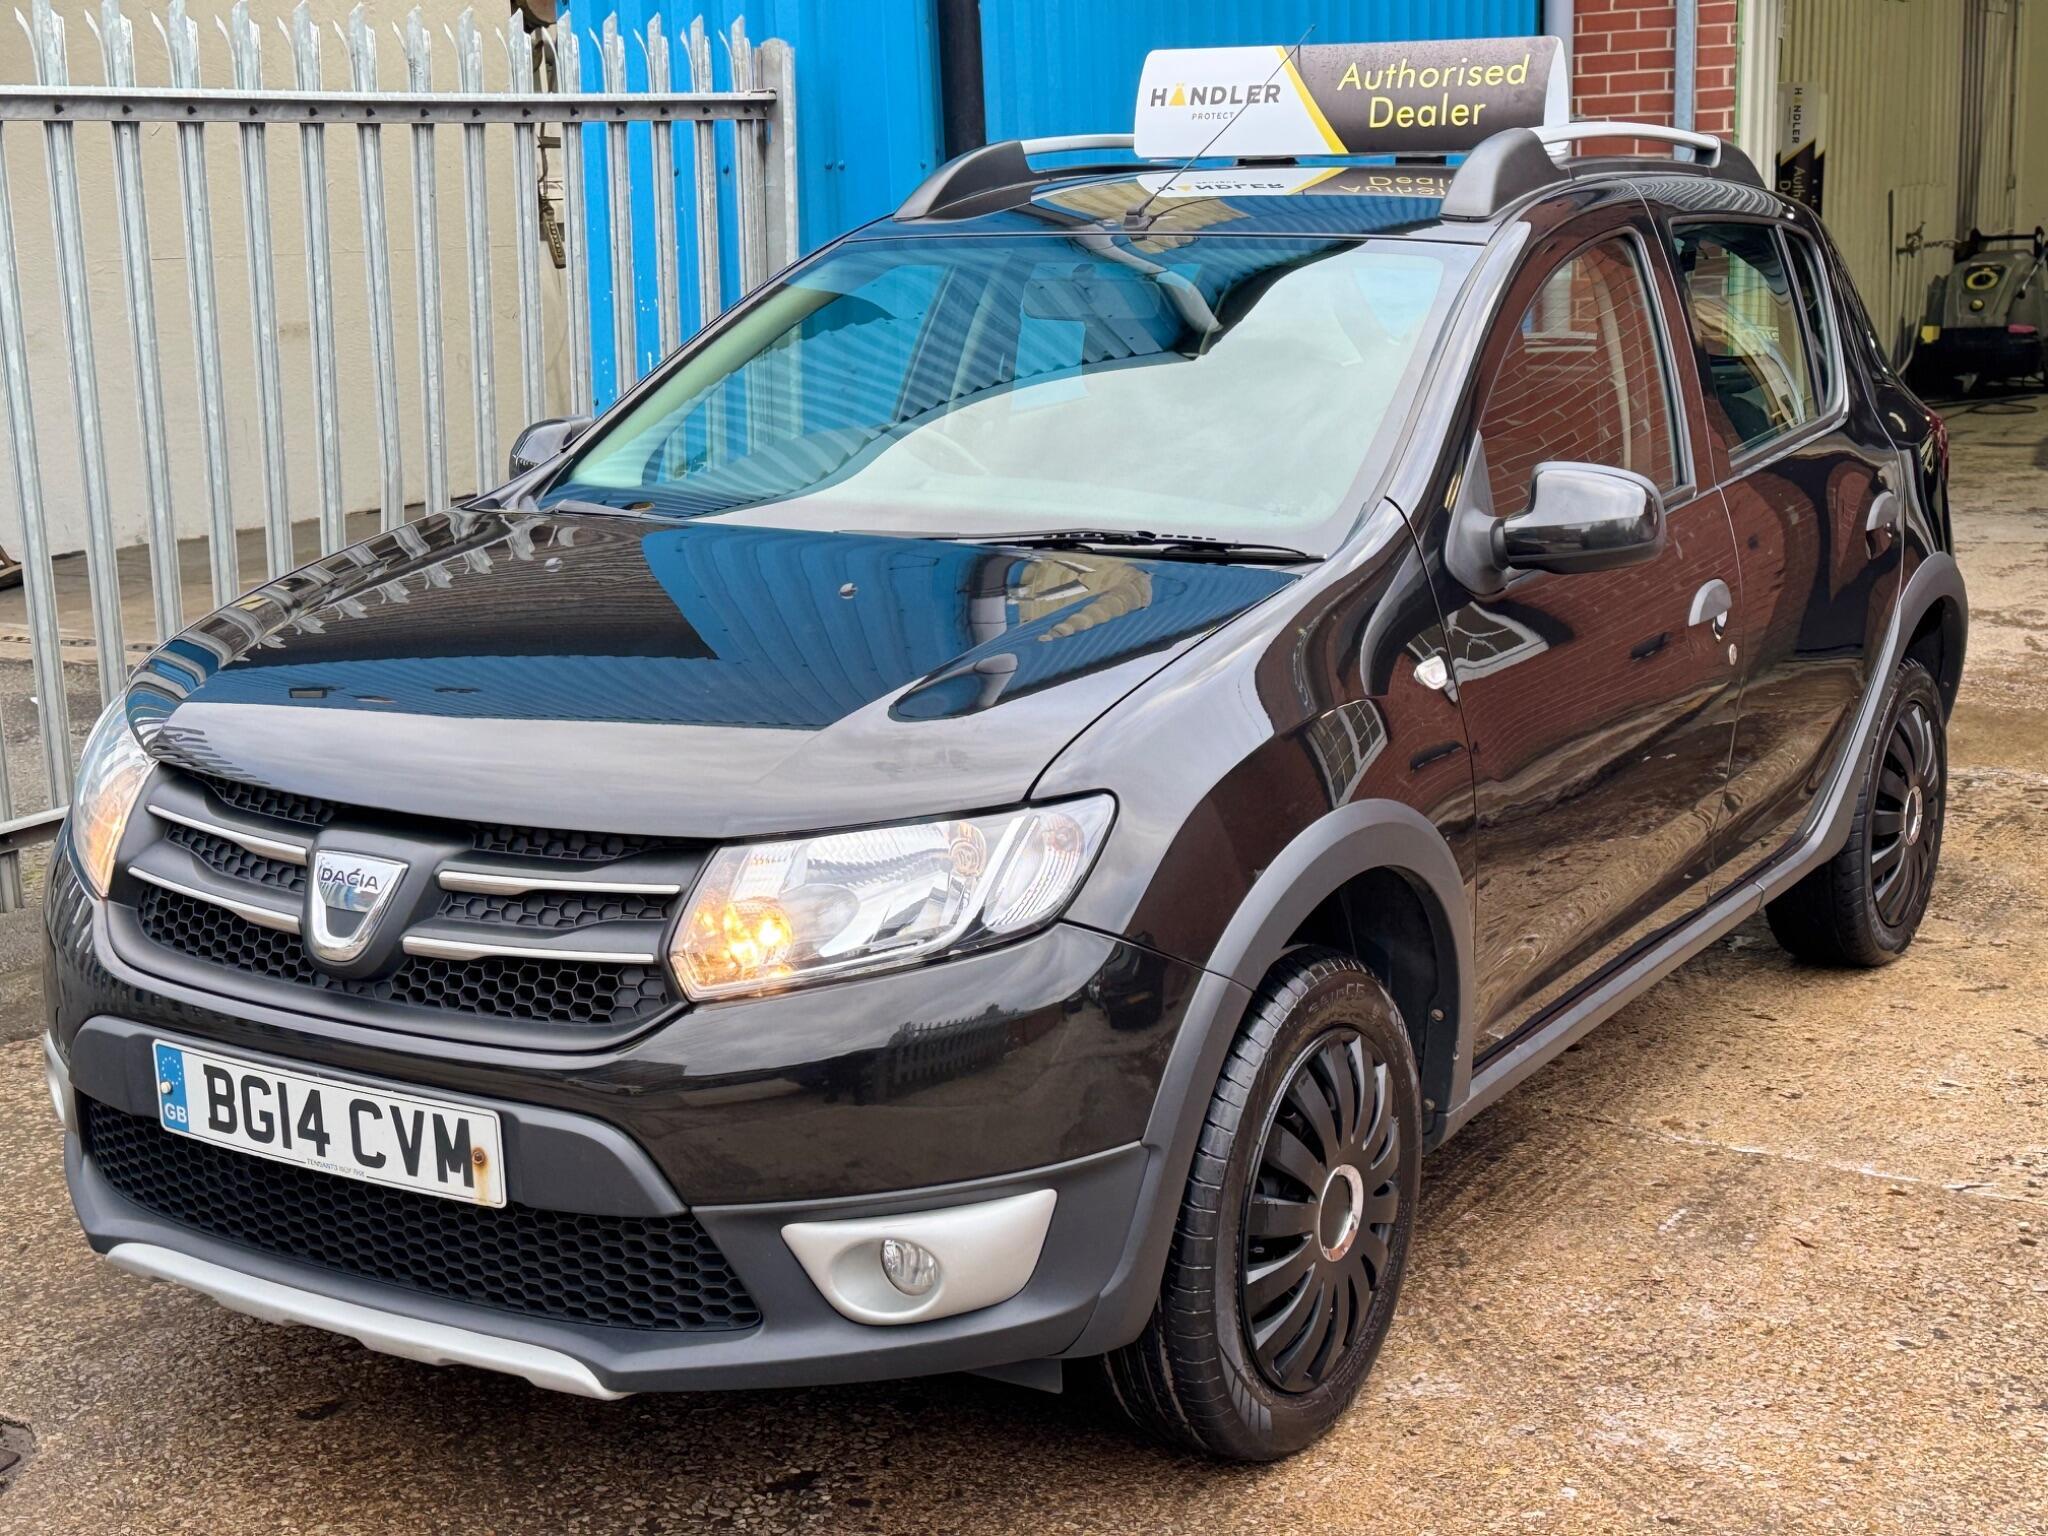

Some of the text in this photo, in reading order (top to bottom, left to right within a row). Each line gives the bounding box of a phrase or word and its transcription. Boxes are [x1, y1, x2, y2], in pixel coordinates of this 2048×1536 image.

[1337, 54, 1530, 91] Authorised
[1192, 112, 1235, 121] PROTECT
[1369, 93, 1486, 128] Dealer
[165, 1103, 187, 1123] GB
[203, 1064, 474, 1188] BG14 CVM
